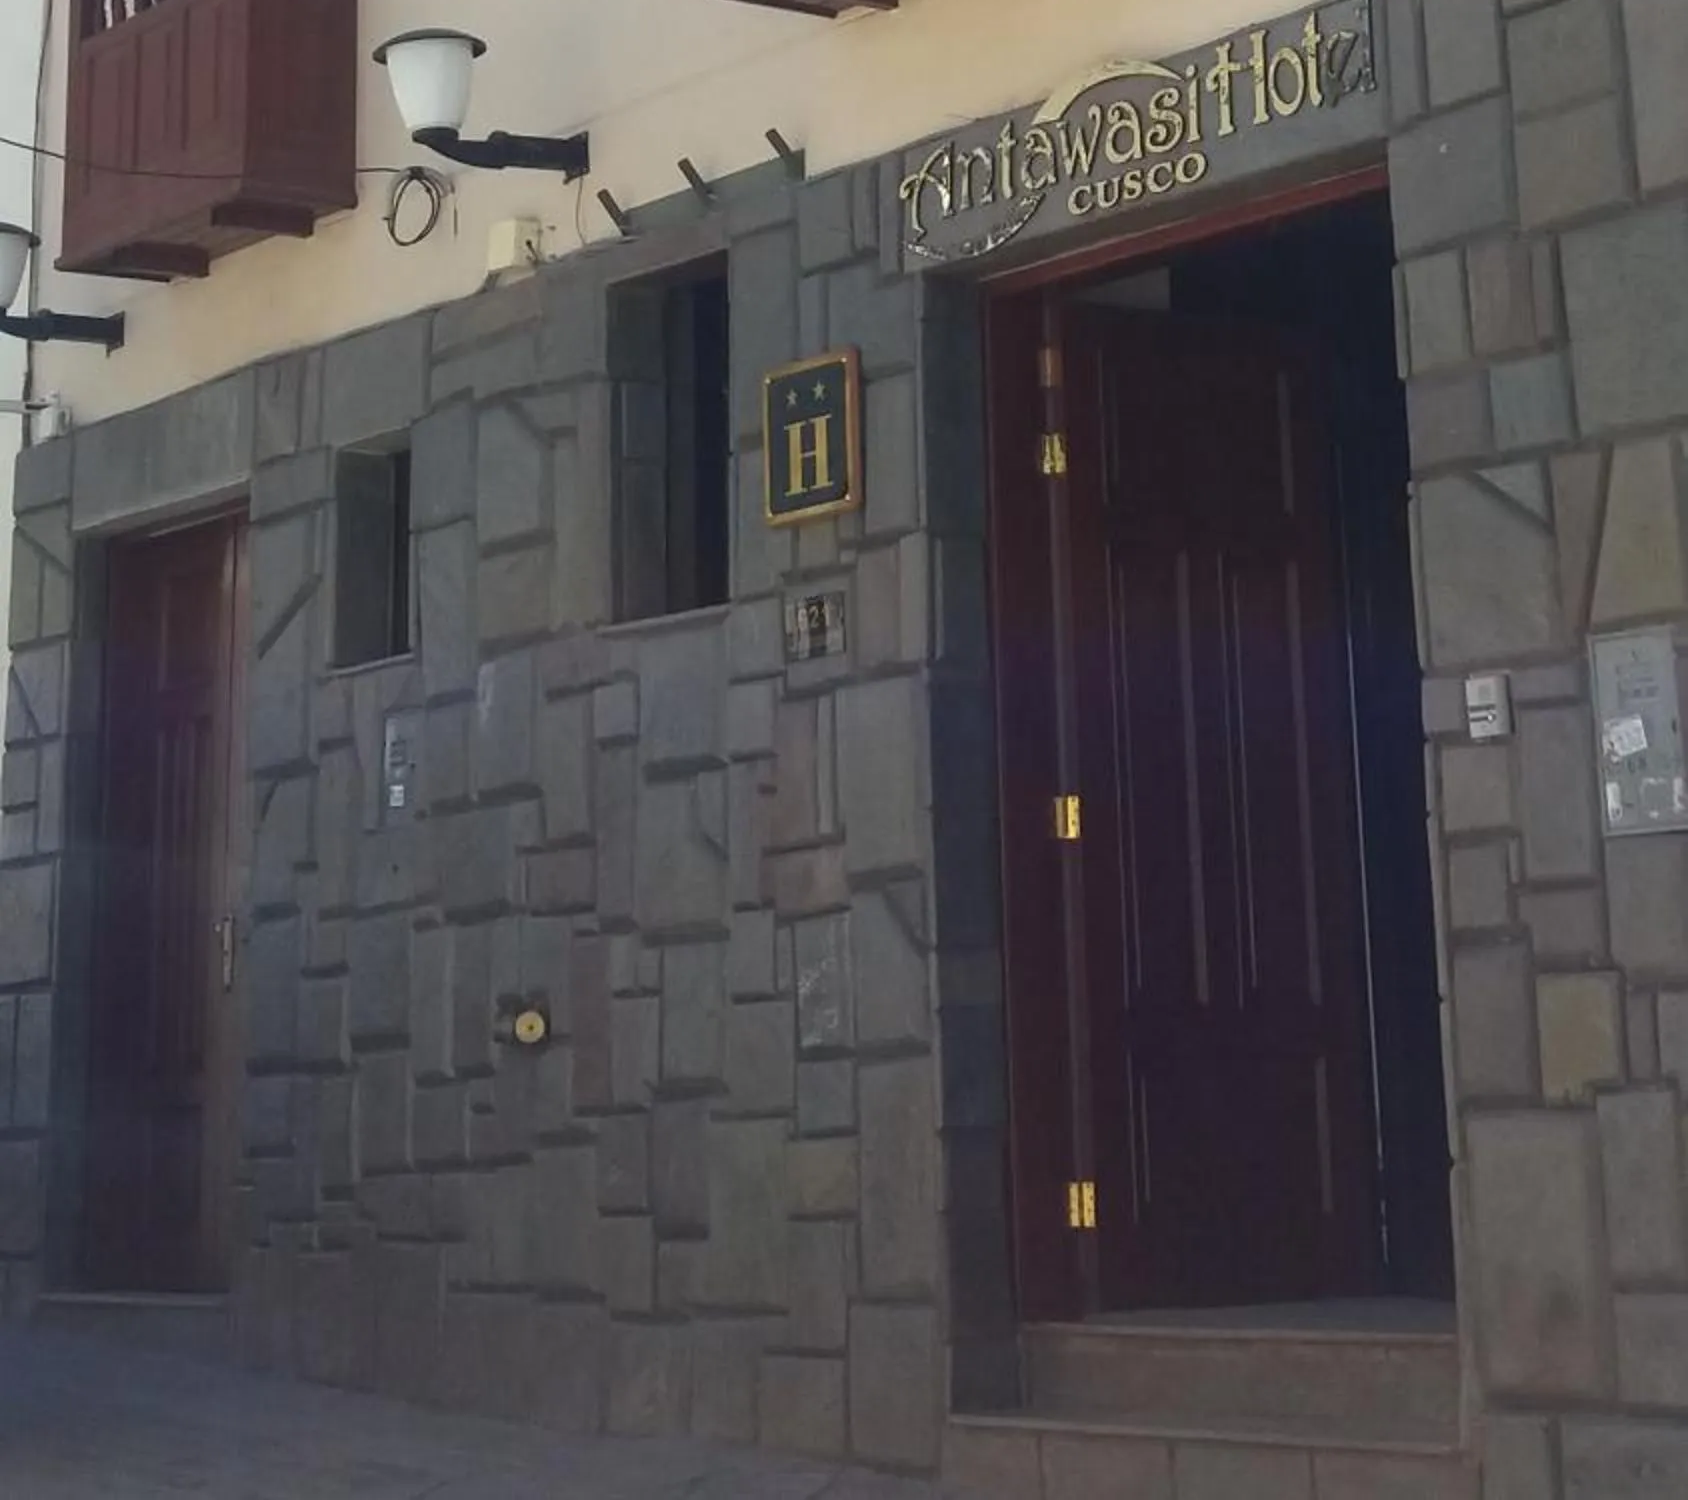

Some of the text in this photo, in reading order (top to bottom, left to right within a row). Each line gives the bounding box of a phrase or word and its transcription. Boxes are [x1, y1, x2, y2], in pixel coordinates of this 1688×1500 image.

[899, 65, 1201, 230] Antawasi
[1067, 152, 1208, 217] CUSCO
[783, 413, 834, 497] H
